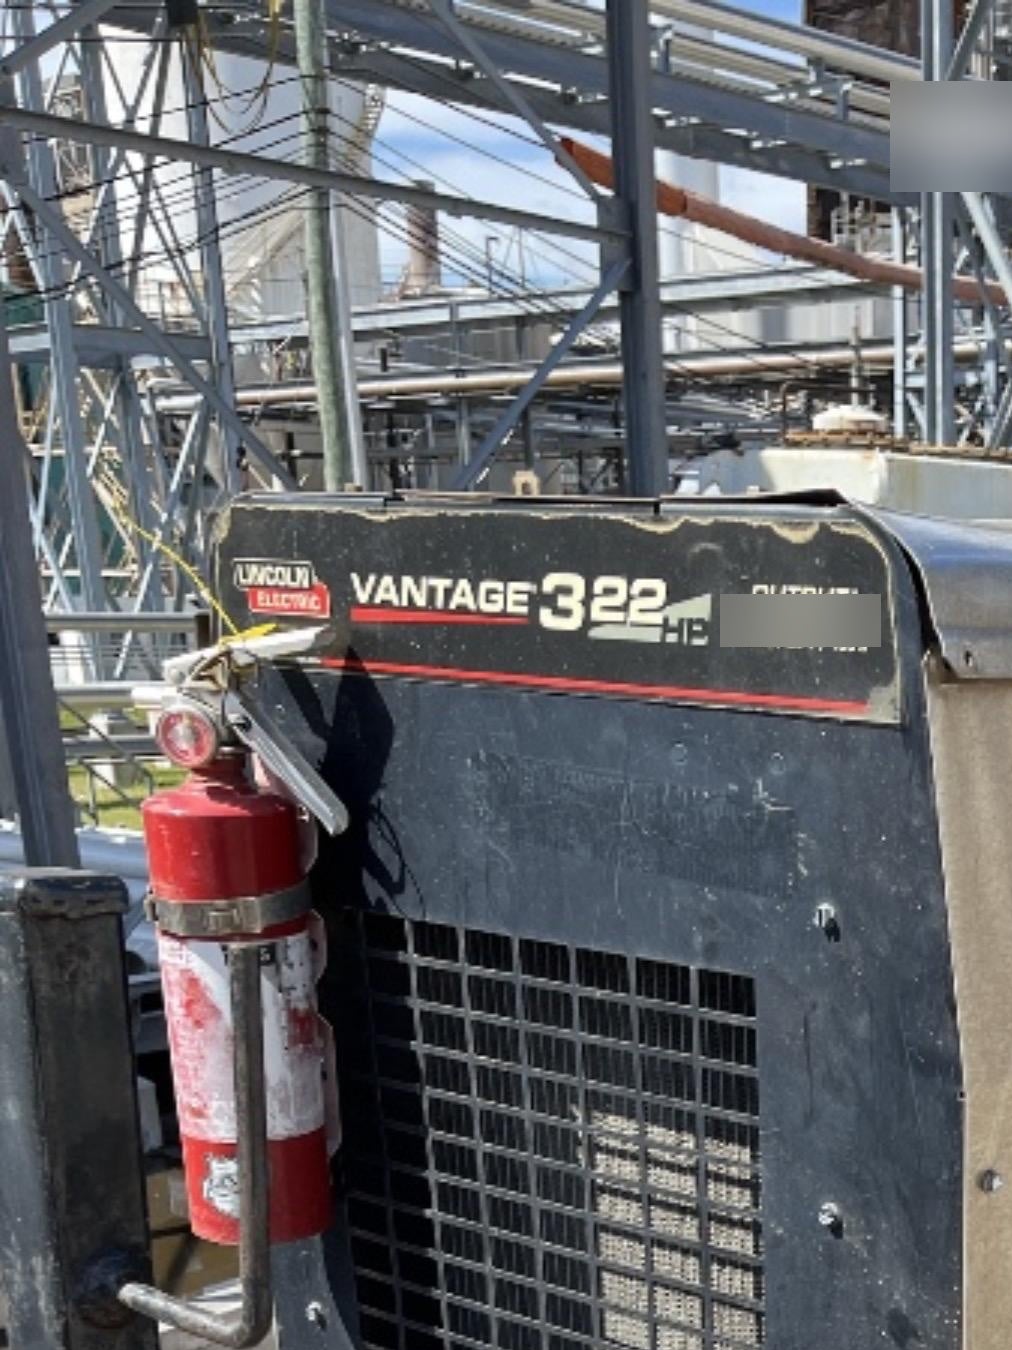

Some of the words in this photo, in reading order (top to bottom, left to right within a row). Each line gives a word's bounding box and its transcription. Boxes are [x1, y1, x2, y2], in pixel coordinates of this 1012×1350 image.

[237, 563, 310, 588] LINCOLN
[256, 590, 322, 611] ELECTRIC
[350, 572, 531, 614] VANTAGE
